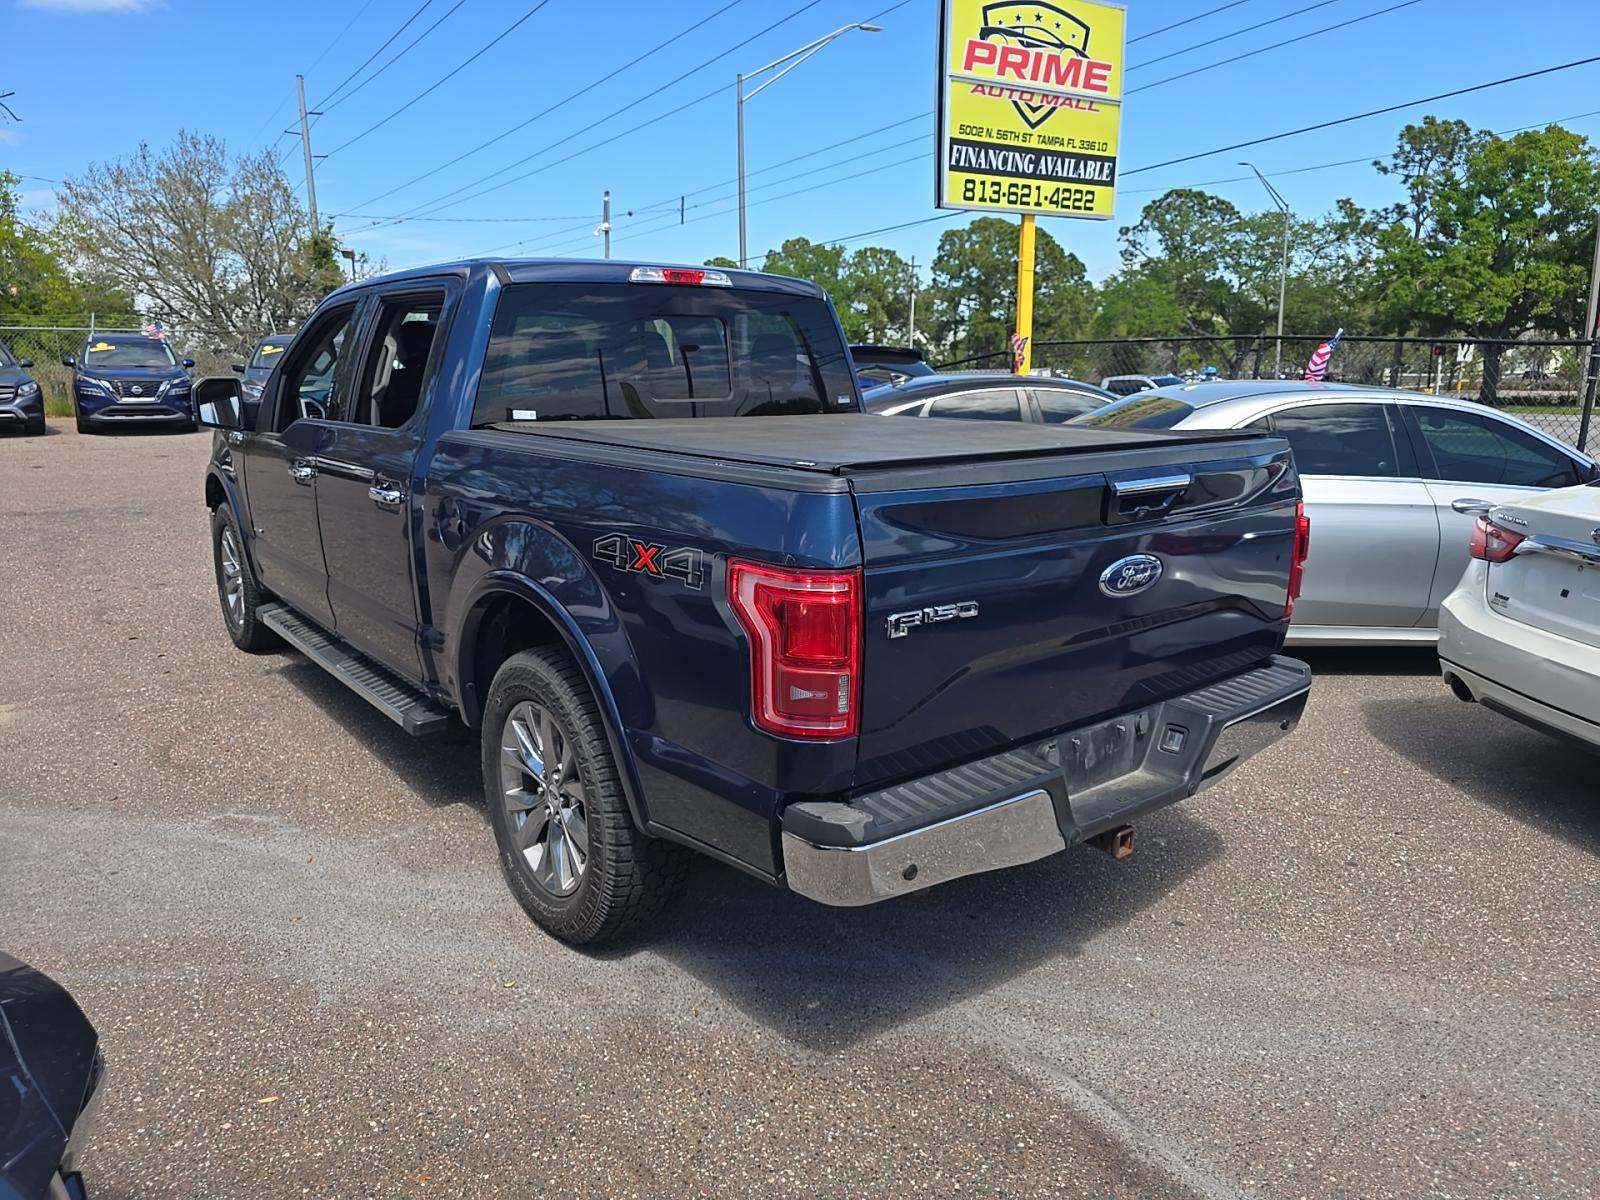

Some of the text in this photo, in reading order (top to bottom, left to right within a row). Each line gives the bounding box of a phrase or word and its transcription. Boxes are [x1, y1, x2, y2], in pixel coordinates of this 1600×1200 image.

[964, 40, 1113, 93] PRIME
[971, 83, 1100, 112] AUTO MALL
[959, 124, 984, 138] 5002
[1021, 132, 1034, 143] ST
[1037, 134, 1065, 147] TAMPA
[1066, 138, 1077, 149] FL
[1078, 139, 1108, 153] 33610
[950, 144, 1113, 181] FINANCING AVAILABLE
[1117, 562, 1153, 589] Ford
